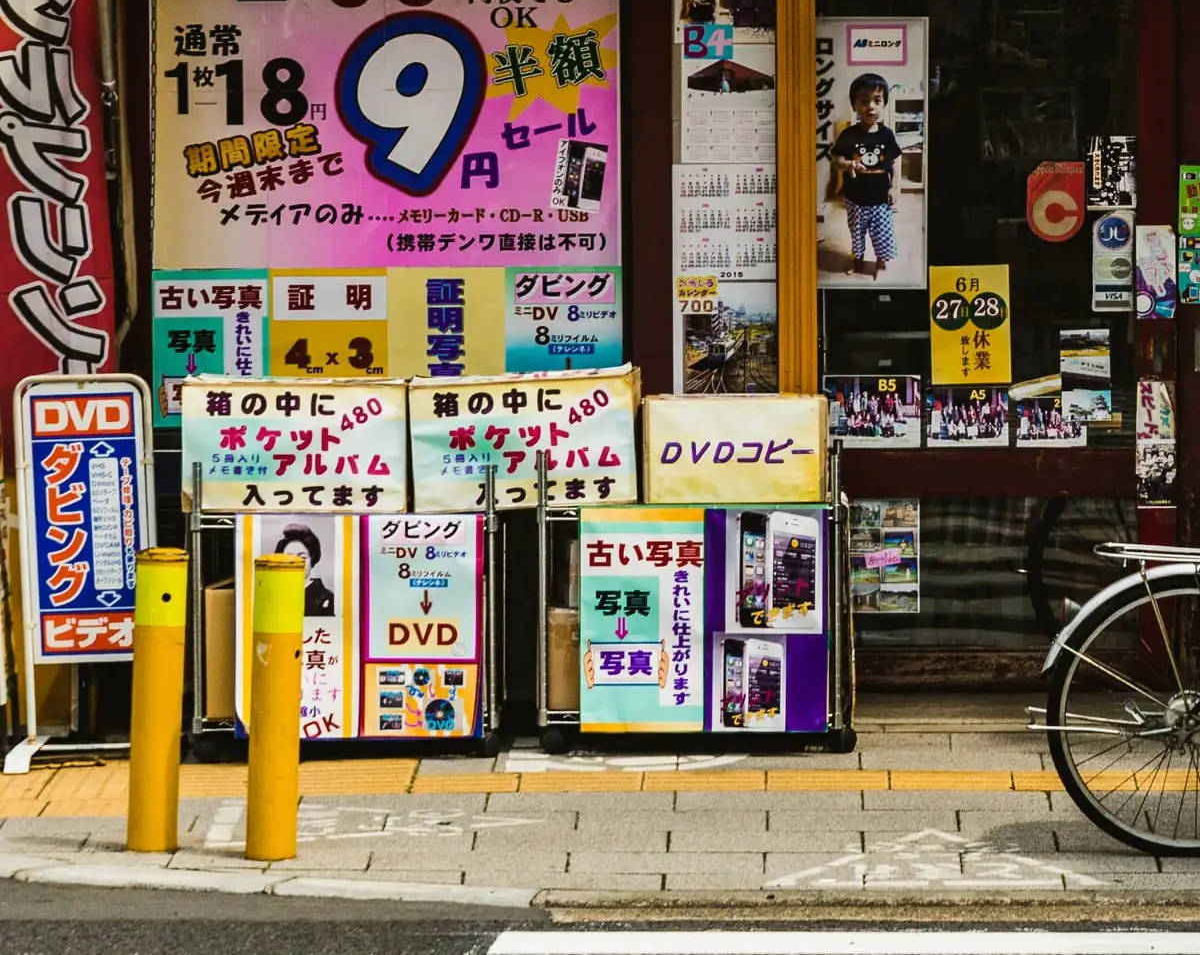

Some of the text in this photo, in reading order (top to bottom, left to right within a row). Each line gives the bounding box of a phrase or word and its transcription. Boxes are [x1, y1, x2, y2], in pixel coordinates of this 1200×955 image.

[490, 7, 538, 28] OK
[174, 24, 242, 58] 通常
[683, 25, 734, 59] B4
[493, 29, 607, 99] 半額
[501, 109, 597, 151] セール
[183, 123, 322, 178] 期間限定
[196, 151, 345, 204] 今週末まで
[159, 285, 262, 310] 古い写真
[287, 284, 372, 311] 証明
[515, 274, 610, 298] ダビング
[956, 277, 980, 293] 6月
[1104, 292, 1123, 300] VISA
[678, 299, 713, 312] 700
[167, 329, 216, 353] 写真
[973, 330, 992, 371] 休業
[878, 379, 896, 391] B5
[970, 390, 986, 400] A5
[34, 399, 131, 433] DVD
[205, 391, 383, 432] 箱の中に 480
[432, 388, 609, 425] 箱の中に 480
[219, 427, 341, 451] ポケット
[448, 421, 569, 451] ポケット
[657, 436, 815, 466] DVDコピー
[272, 453, 390, 477] アルバム
[243, 484, 385, 508] 入ってます
[40, 441, 90, 608] ダビング
[381, 520, 462, 540] ダビング
[586, 540, 705, 568] 古い写真
[594, 589, 651, 617] 写真
[45, 618, 134, 649] ビデオ
[389, 622, 458, 646] DVD
[672, 569, 691, 706] きれいに仕上がります
[599, 650, 653, 676] 写真
[303, 713, 340, 739] OK
